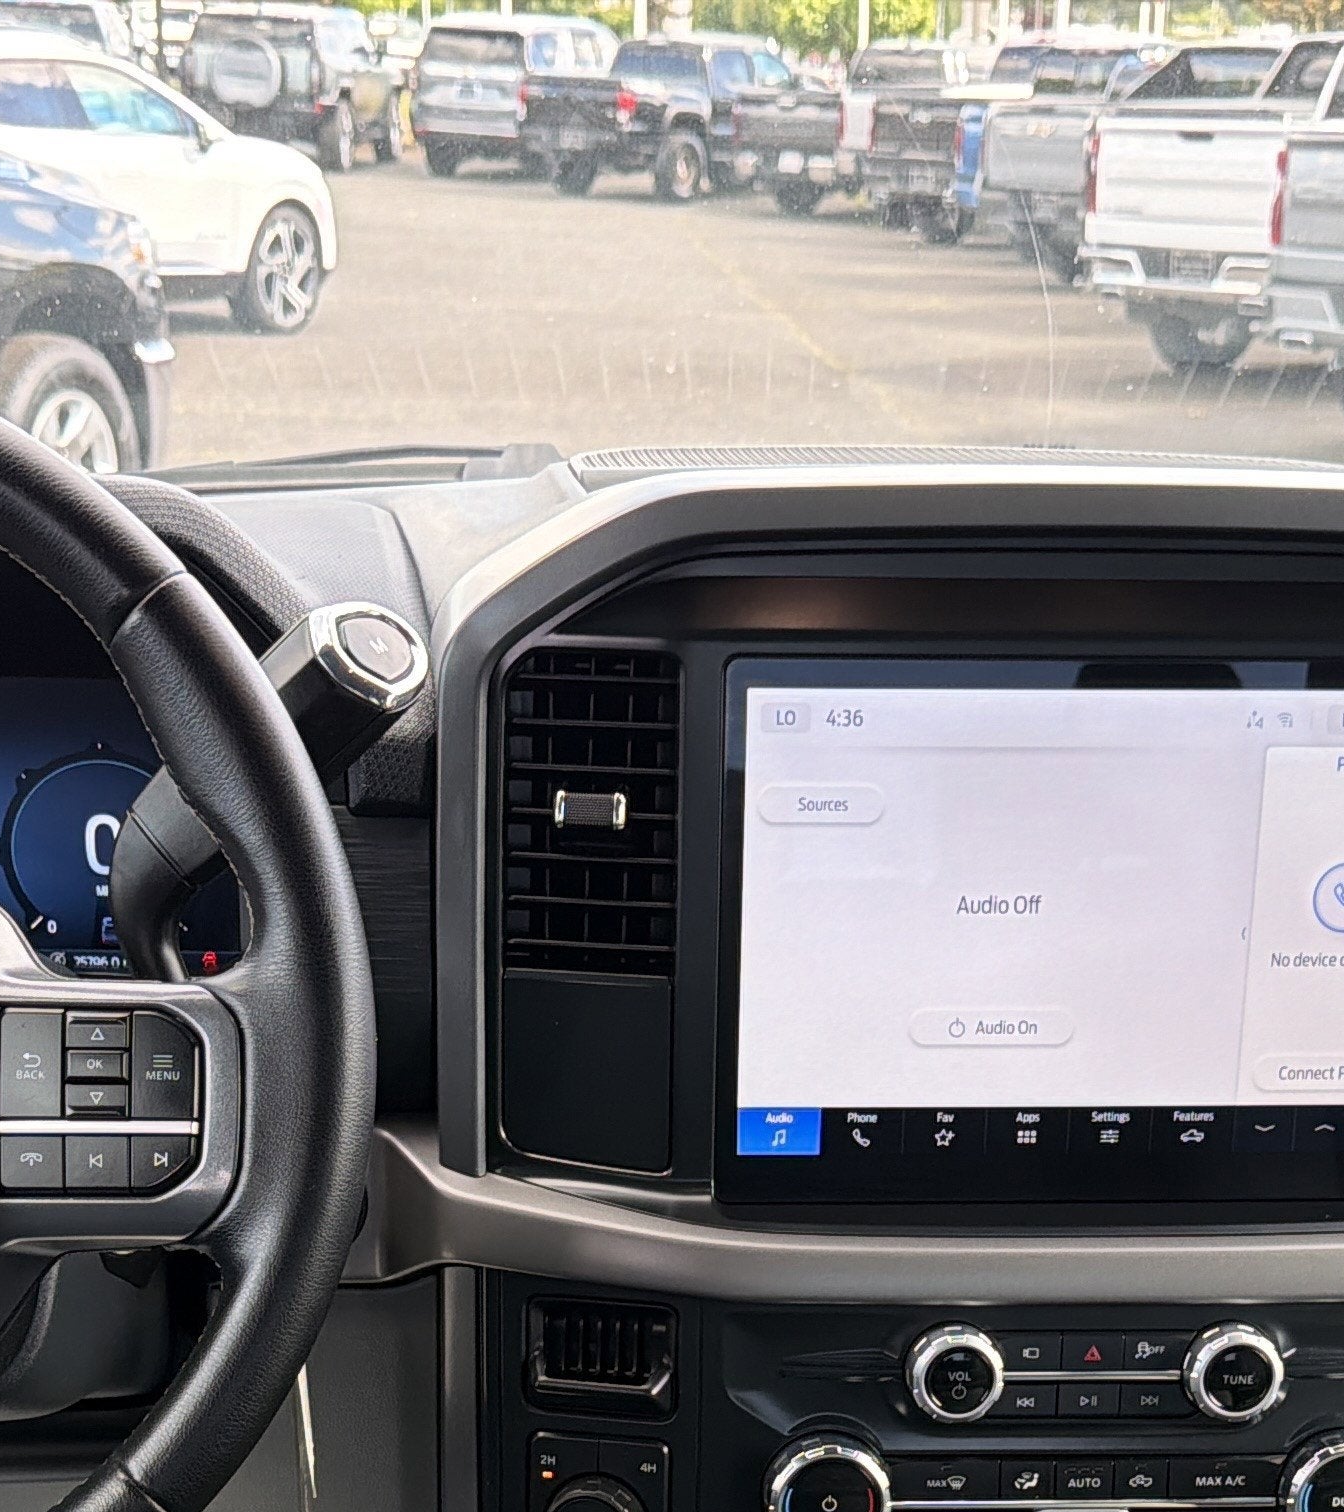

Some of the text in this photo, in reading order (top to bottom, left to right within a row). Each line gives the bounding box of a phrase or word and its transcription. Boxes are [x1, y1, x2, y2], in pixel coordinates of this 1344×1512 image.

[369, 637, 389, 654] M
[776, 710, 796, 726] LO
[826, 709, 864, 727] 4:36
[798, 797, 849, 812] Sources
[956, 895, 1043, 914] Audio Off
[47, 920, 57, 934] 0
[1271, 952, 1290, 968] No
[1293, 952, 1337, 968] device
[975, 1020, 1038, 1035] Audio On
[86, 1059, 103, 1070] OK
[16, 1070, 45, 1080] BACK
[146, 1071, 181, 1081] MENU
[1278, 1065, 1334, 1081] Connect
[765, 1112, 794, 1124] Audio
[847, 1112, 878, 1124] Phone
[936, 1112, 955, 1123] Fav
[1015, 1112, 1040, 1125] Apps
[1091, 1112, 1131, 1125] Settings
[1173, 1111, 1214, 1123] Features
[948, 1371, 971, 1382] VOL
[1223, 1374, 1255, 1385] TUNE
[540, 1455, 556, 1466] 2H
[639, 1463, 657, 1474] 4H
[927, 1479, 947, 1488] MAX
[1068, 1478, 1101, 1488] AUTO
[1195, 1475, 1246, 1487] MAX A/C
